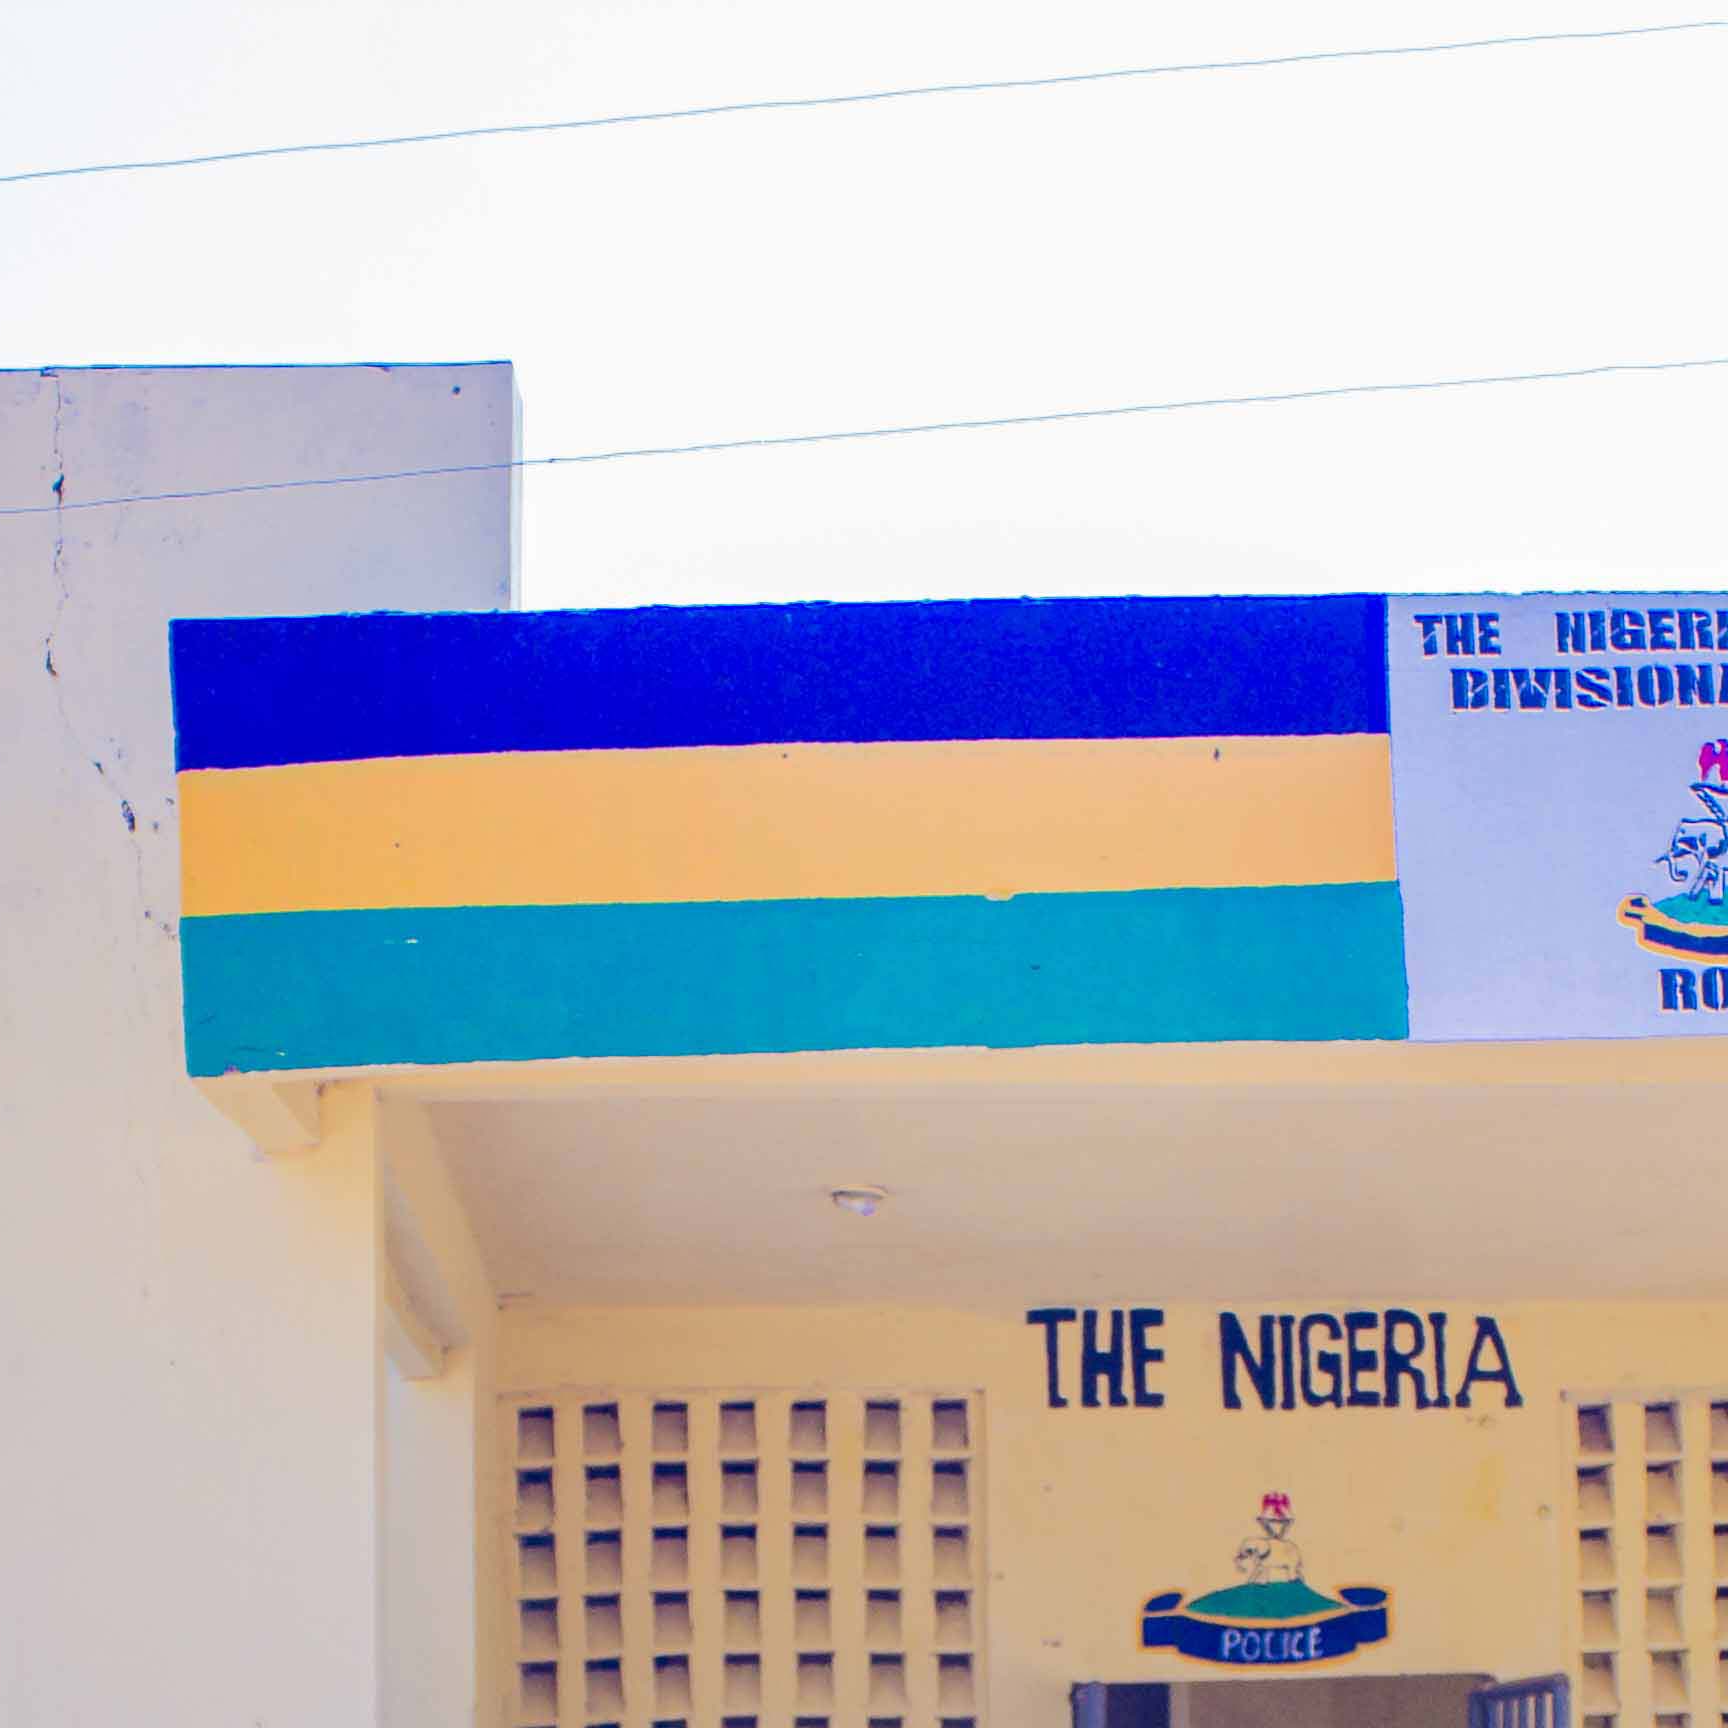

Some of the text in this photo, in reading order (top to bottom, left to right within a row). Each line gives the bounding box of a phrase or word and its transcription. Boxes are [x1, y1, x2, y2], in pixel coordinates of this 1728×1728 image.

[1413, 611, 1502, 656] THE
[1026, 1307, 1524, 1410] THE NIGERIA
[1220, 1626, 1324, 1662] POLICE
